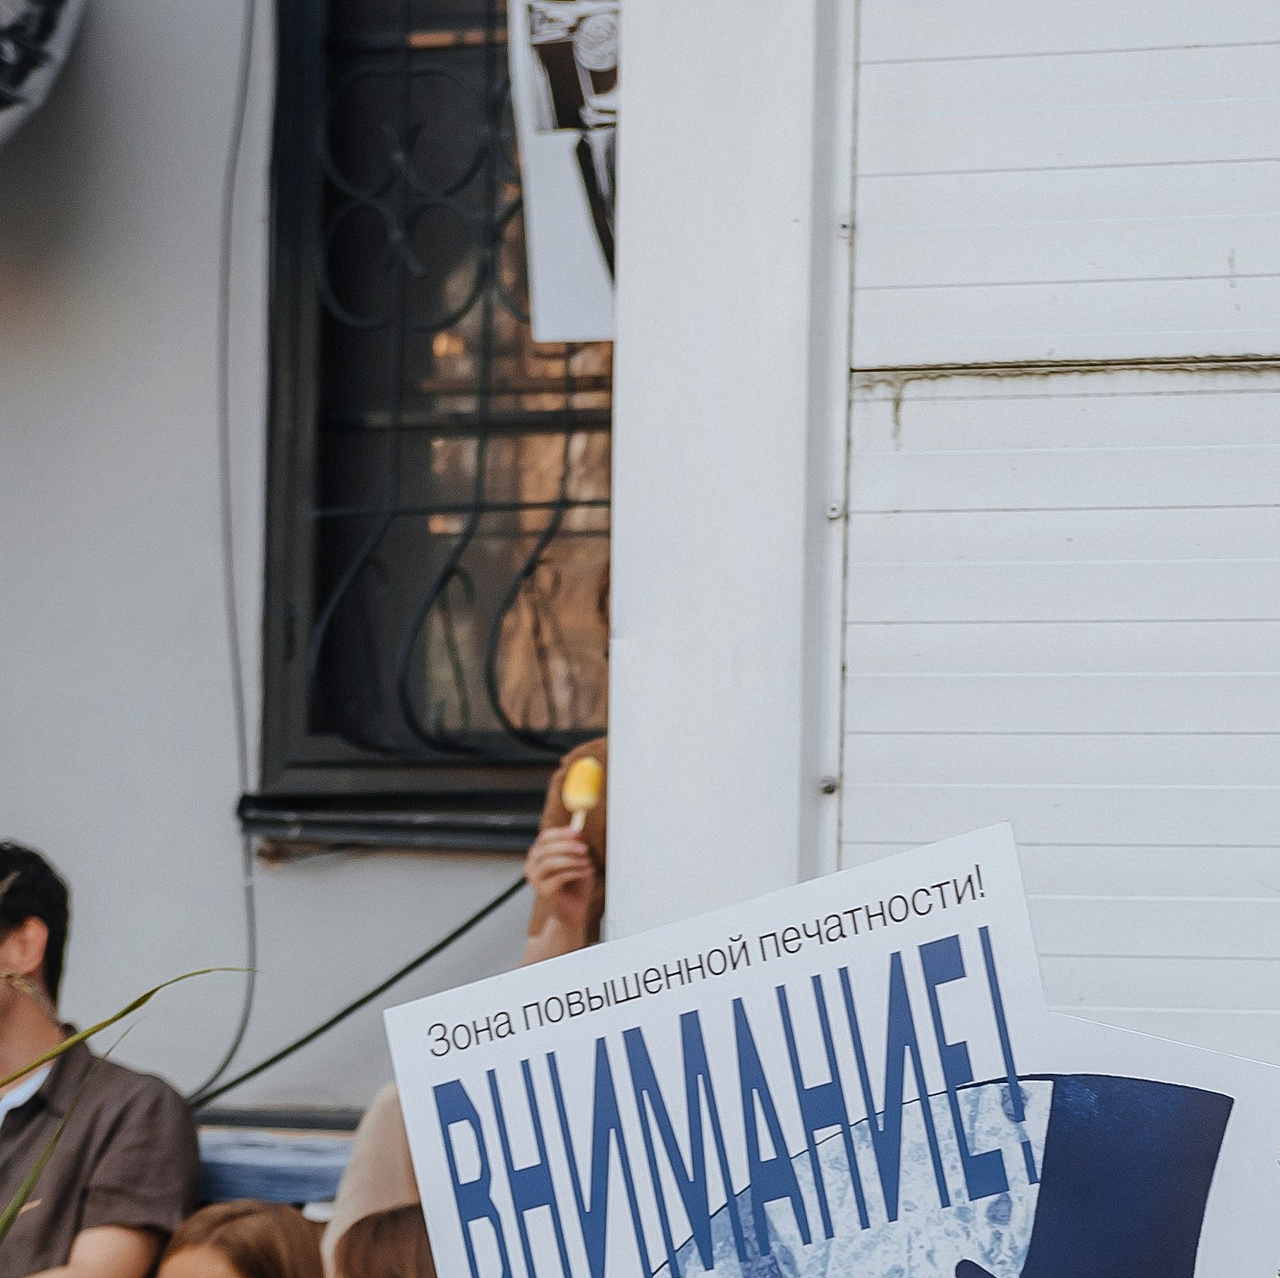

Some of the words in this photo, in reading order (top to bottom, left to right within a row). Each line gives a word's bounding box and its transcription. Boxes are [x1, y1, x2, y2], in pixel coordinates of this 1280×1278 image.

[428, 1011, 515, 1057] Зона
[522, 934, 751, 1031] повышенной
[758, 864, 986, 962] печатности!
